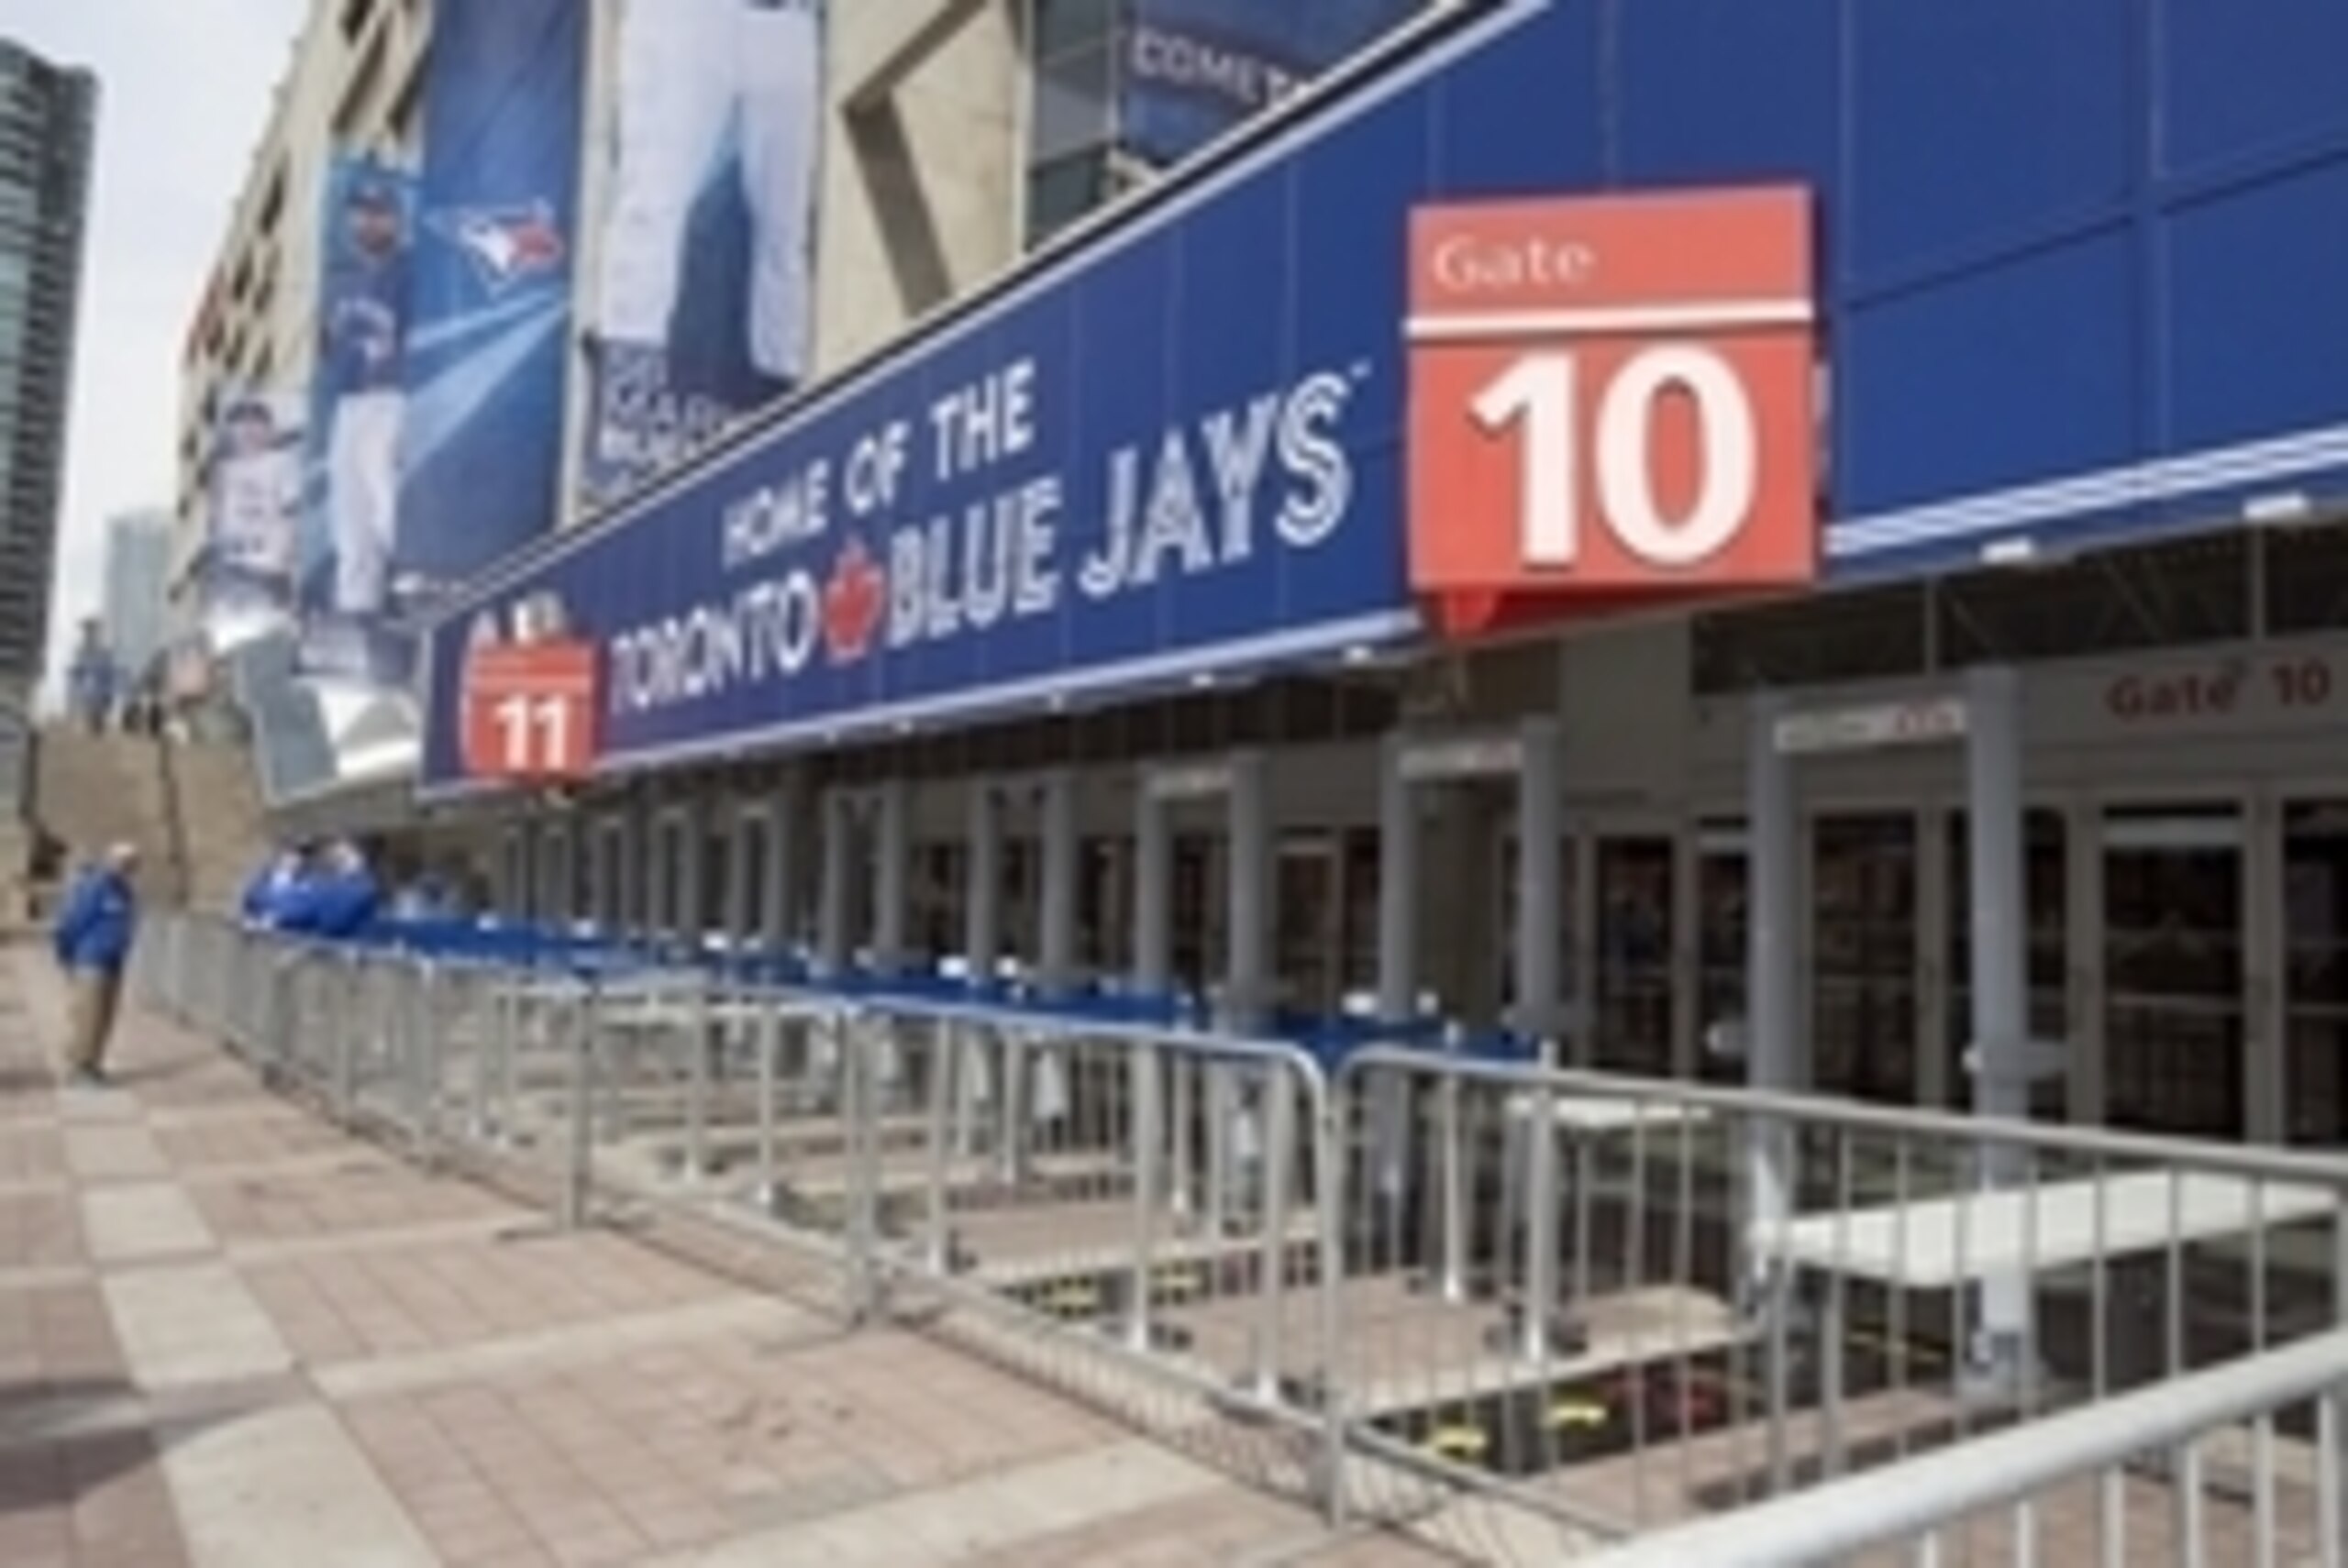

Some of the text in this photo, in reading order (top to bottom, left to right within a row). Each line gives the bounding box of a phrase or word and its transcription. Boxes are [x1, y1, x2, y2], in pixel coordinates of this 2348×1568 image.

[1432, 232, 1594, 293] Gate
[723, 355, 1036, 572] HOME OF THE
[1468, 340, 1759, 570] 10
[608, 371, 1352, 717] TORONTO BLUE JAYS
[493, 690, 572, 772] 11
[2105, 657, 2332, 726] Gate 10
